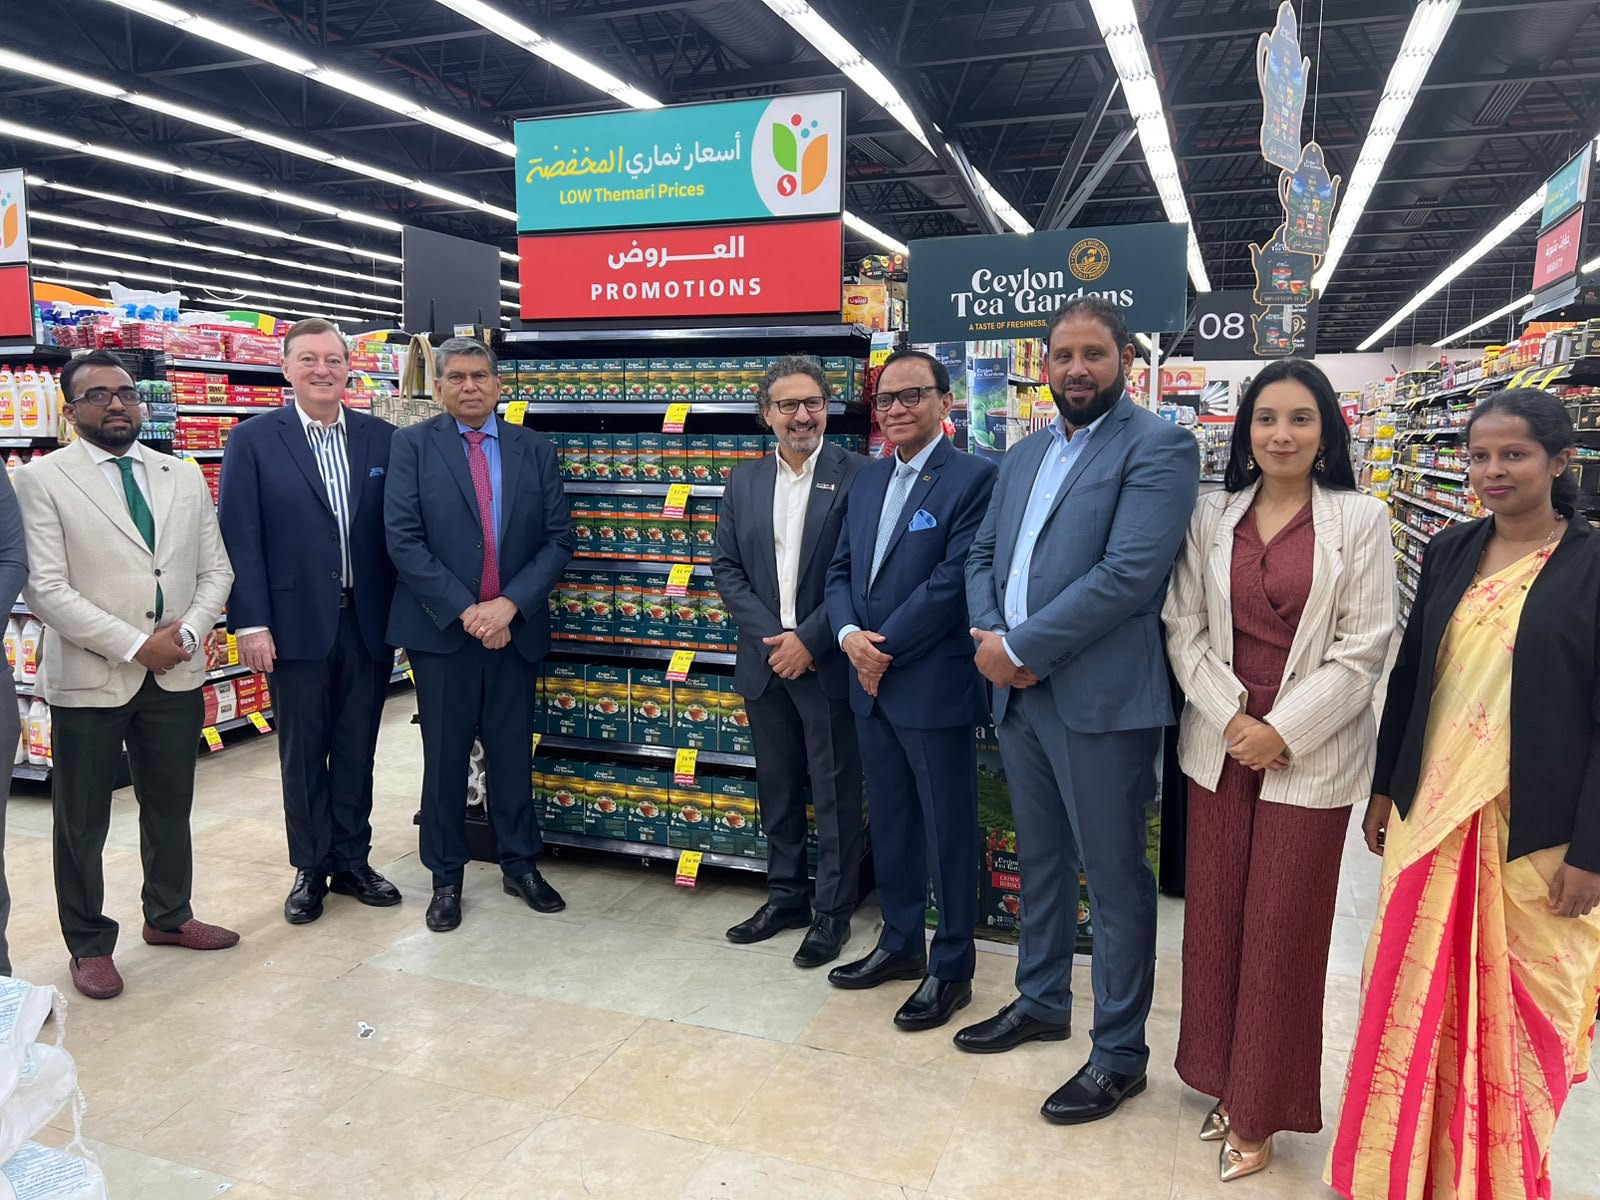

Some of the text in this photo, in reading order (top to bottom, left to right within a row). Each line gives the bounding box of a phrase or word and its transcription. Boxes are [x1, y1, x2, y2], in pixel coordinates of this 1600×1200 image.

[525, 131, 742, 184] أسعار ثماري المخفضة
[560, 182, 705, 205] LOW Themari Prices
[591, 277, 761, 301] PROMOTIONS
[971, 268, 1064, 297] Ceylon
[951, 292, 1004, 317] Tea
[975, 323, 995, 331] TASTE
[996, 322, 1005, 330] OF
[1006, 319, 1048, 329] FRESHNESS,
[1199, 312, 1245, 340] 08
